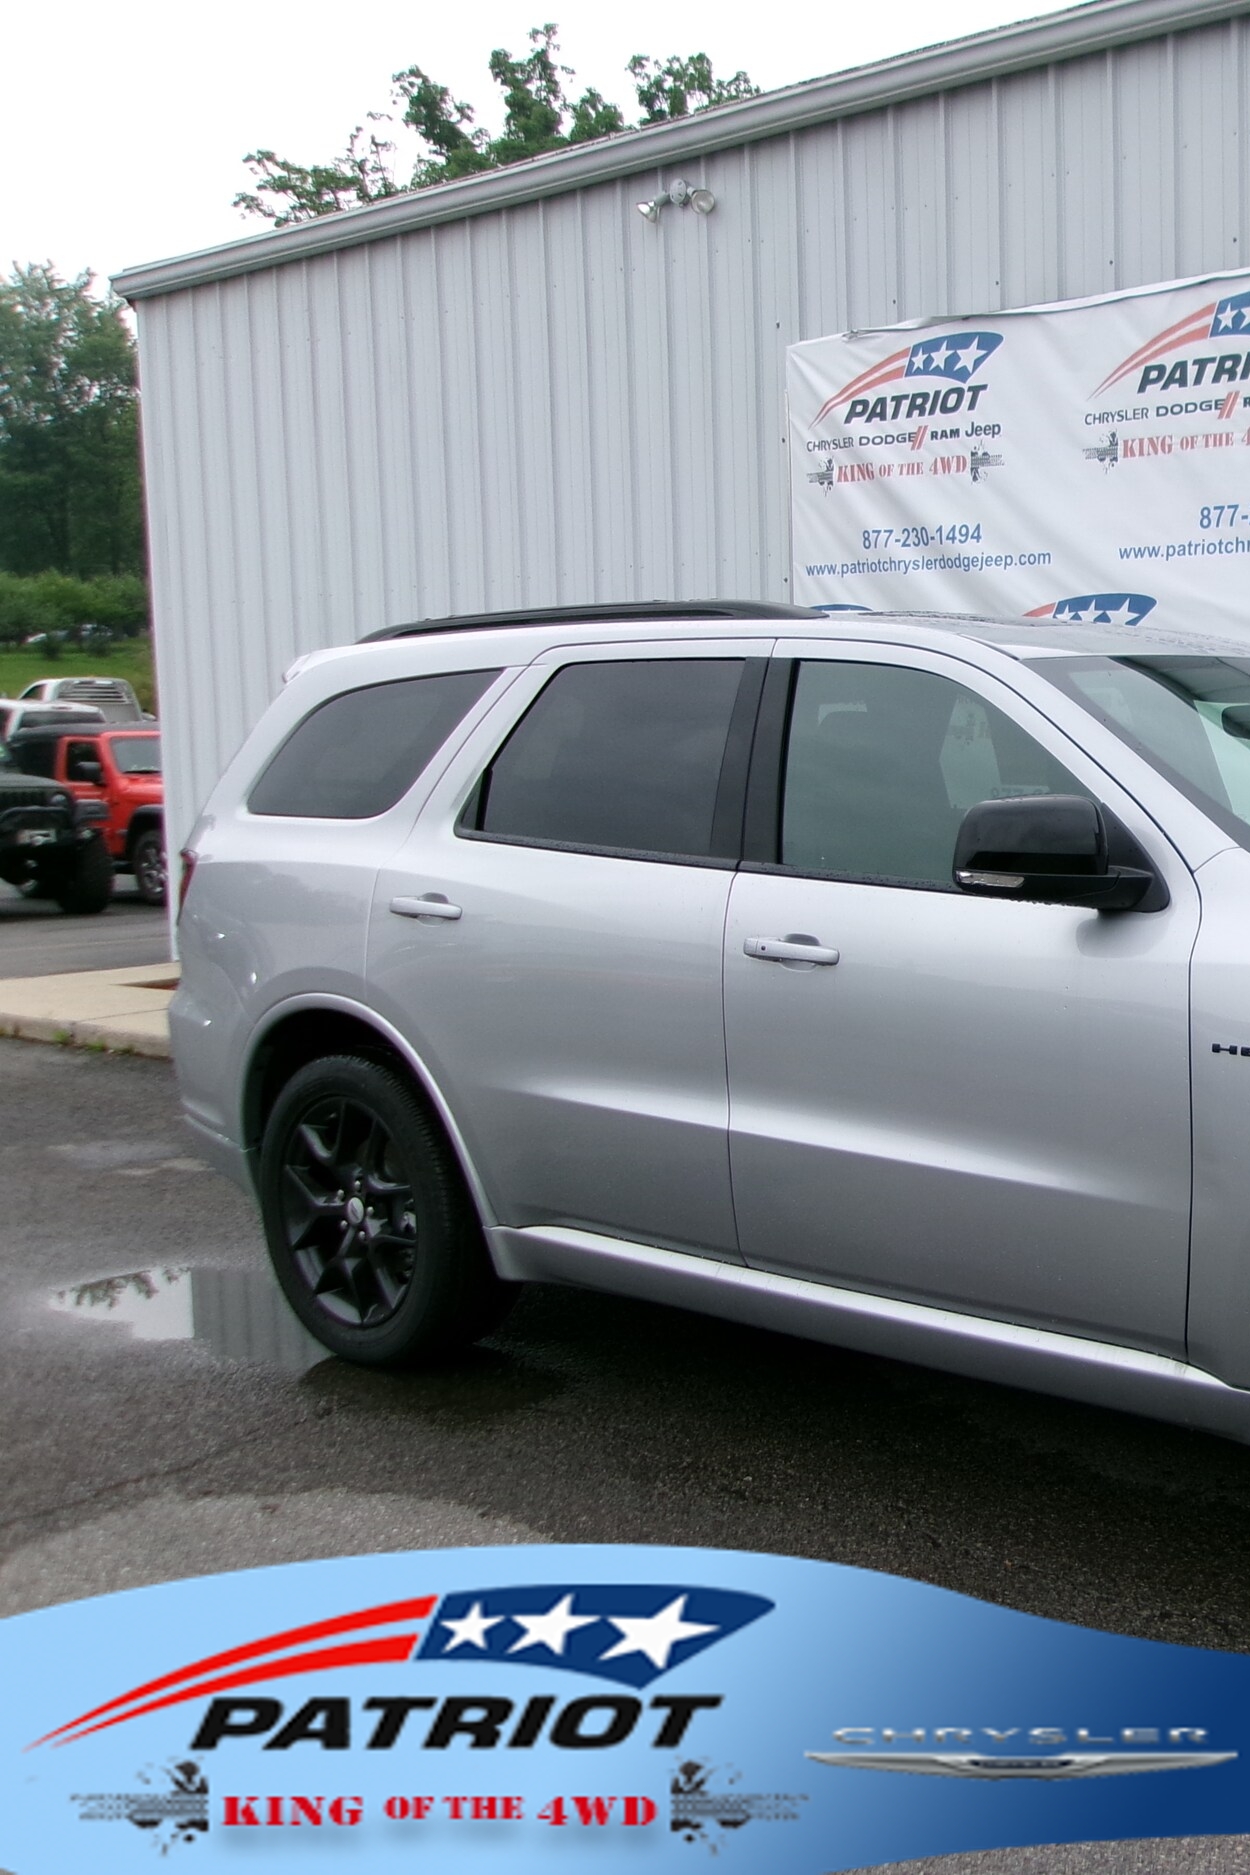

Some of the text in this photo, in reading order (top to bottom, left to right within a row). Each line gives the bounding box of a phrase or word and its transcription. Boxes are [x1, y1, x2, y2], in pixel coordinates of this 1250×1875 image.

[844, 384, 988, 424] PATRIOT
[1084, 407, 1150, 426] CHRYSLER
[1155, 399, 1225, 417] DODGE
[806, 422, 1001, 453] CHRYSLER DODGE RAM Jeep
[1122, 435, 1173, 458] KING
[1179, 435, 1200, 450] OF
[1202, 432, 1234, 447] THE
[836, 454, 967, 483] KING OF THE 4WD
[862, 523, 982, 549] 877-230-1494
[806, 549, 1052, 577] www.patriotchryslerdodgejeep.com
